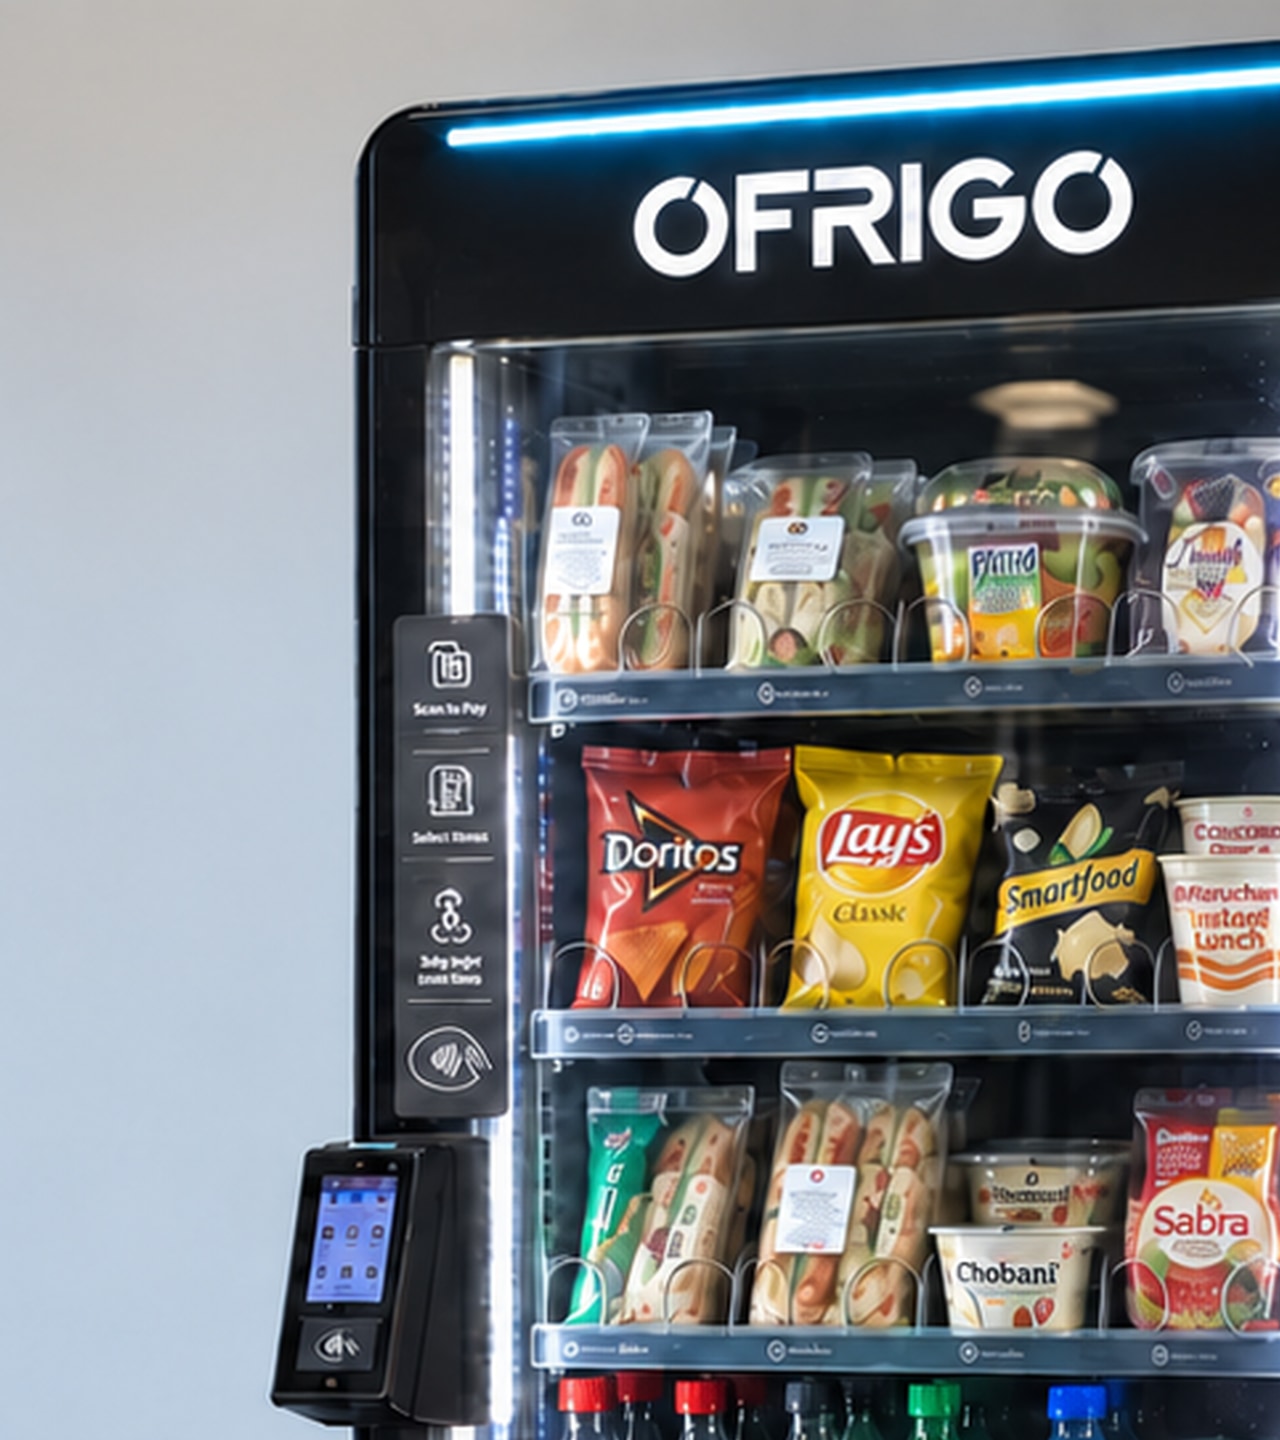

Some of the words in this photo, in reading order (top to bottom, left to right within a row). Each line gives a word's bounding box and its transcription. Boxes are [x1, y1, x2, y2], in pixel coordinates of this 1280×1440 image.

[633, 150, 1134, 278] OFRIGO
[604, 832, 741, 873] Doritos
[1006, 859, 1138, 913] Smartfood
[1153, 1203, 1249, 1236] Sabra
[957, 1261, 1057, 1285] Chobani
